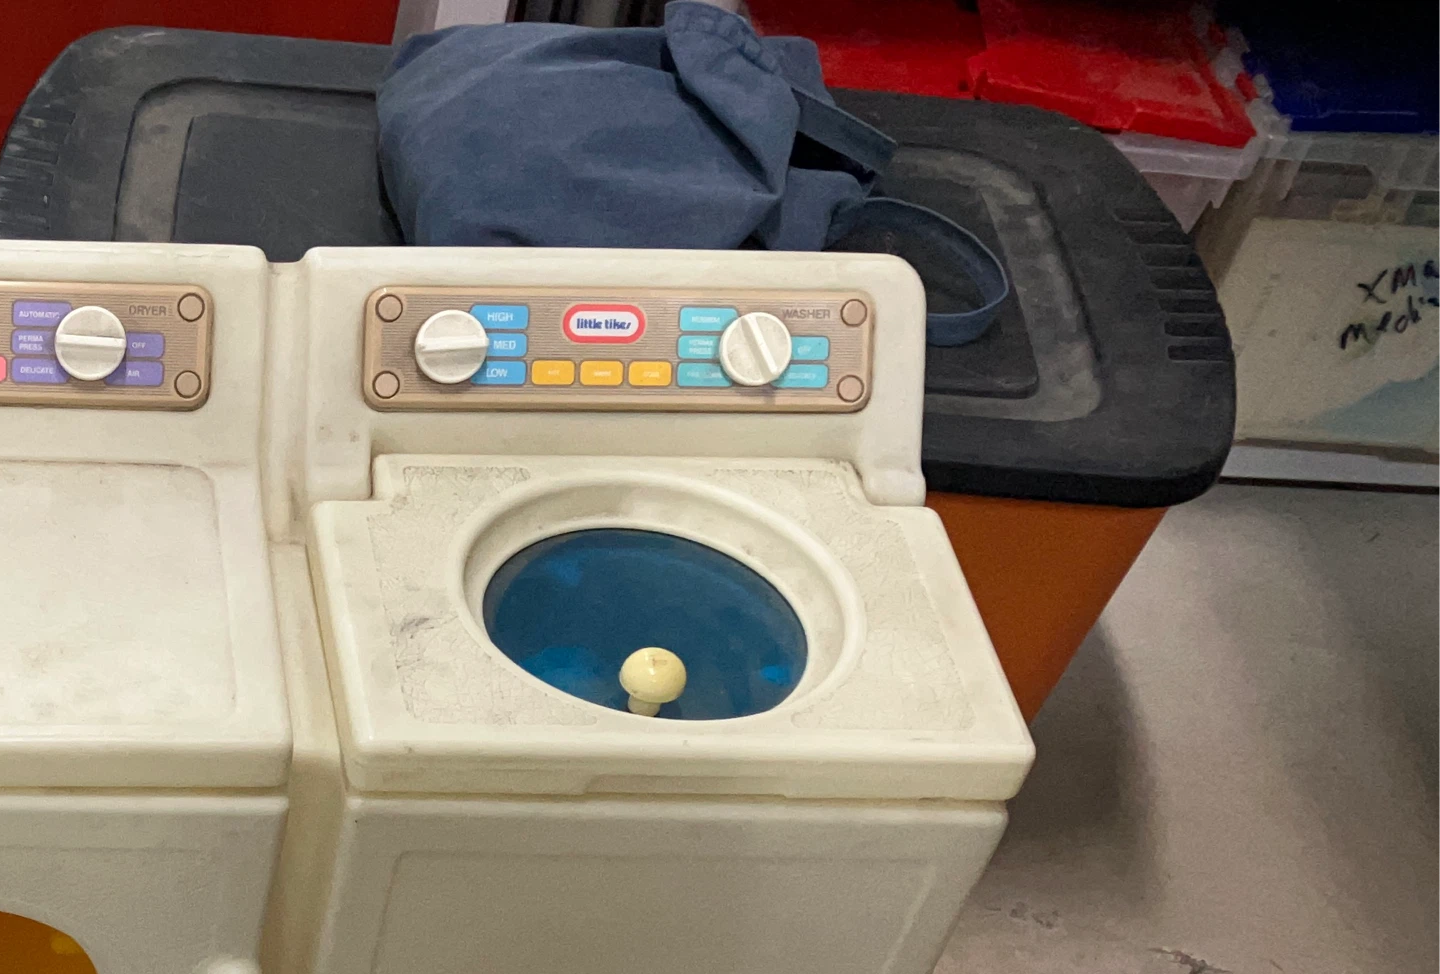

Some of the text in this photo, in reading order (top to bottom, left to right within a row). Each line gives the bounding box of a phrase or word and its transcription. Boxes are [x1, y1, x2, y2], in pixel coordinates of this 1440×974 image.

[128, 305, 167, 316] DRYER
[782, 309, 831, 319] WASHER
[487, 312, 514, 322] HIGH
[576, 318, 632, 330] little tikes
[18, 334, 43, 343] PERMA
[19, 343, 42, 351] PRESS
[131, 342, 147, 350] OFF
[493, 340, 517, 350] MED
[20, 366, 54, 375] DELICATE
[127, 370, 140, 378] AIR
[486, 368, 508, 378] LOW
